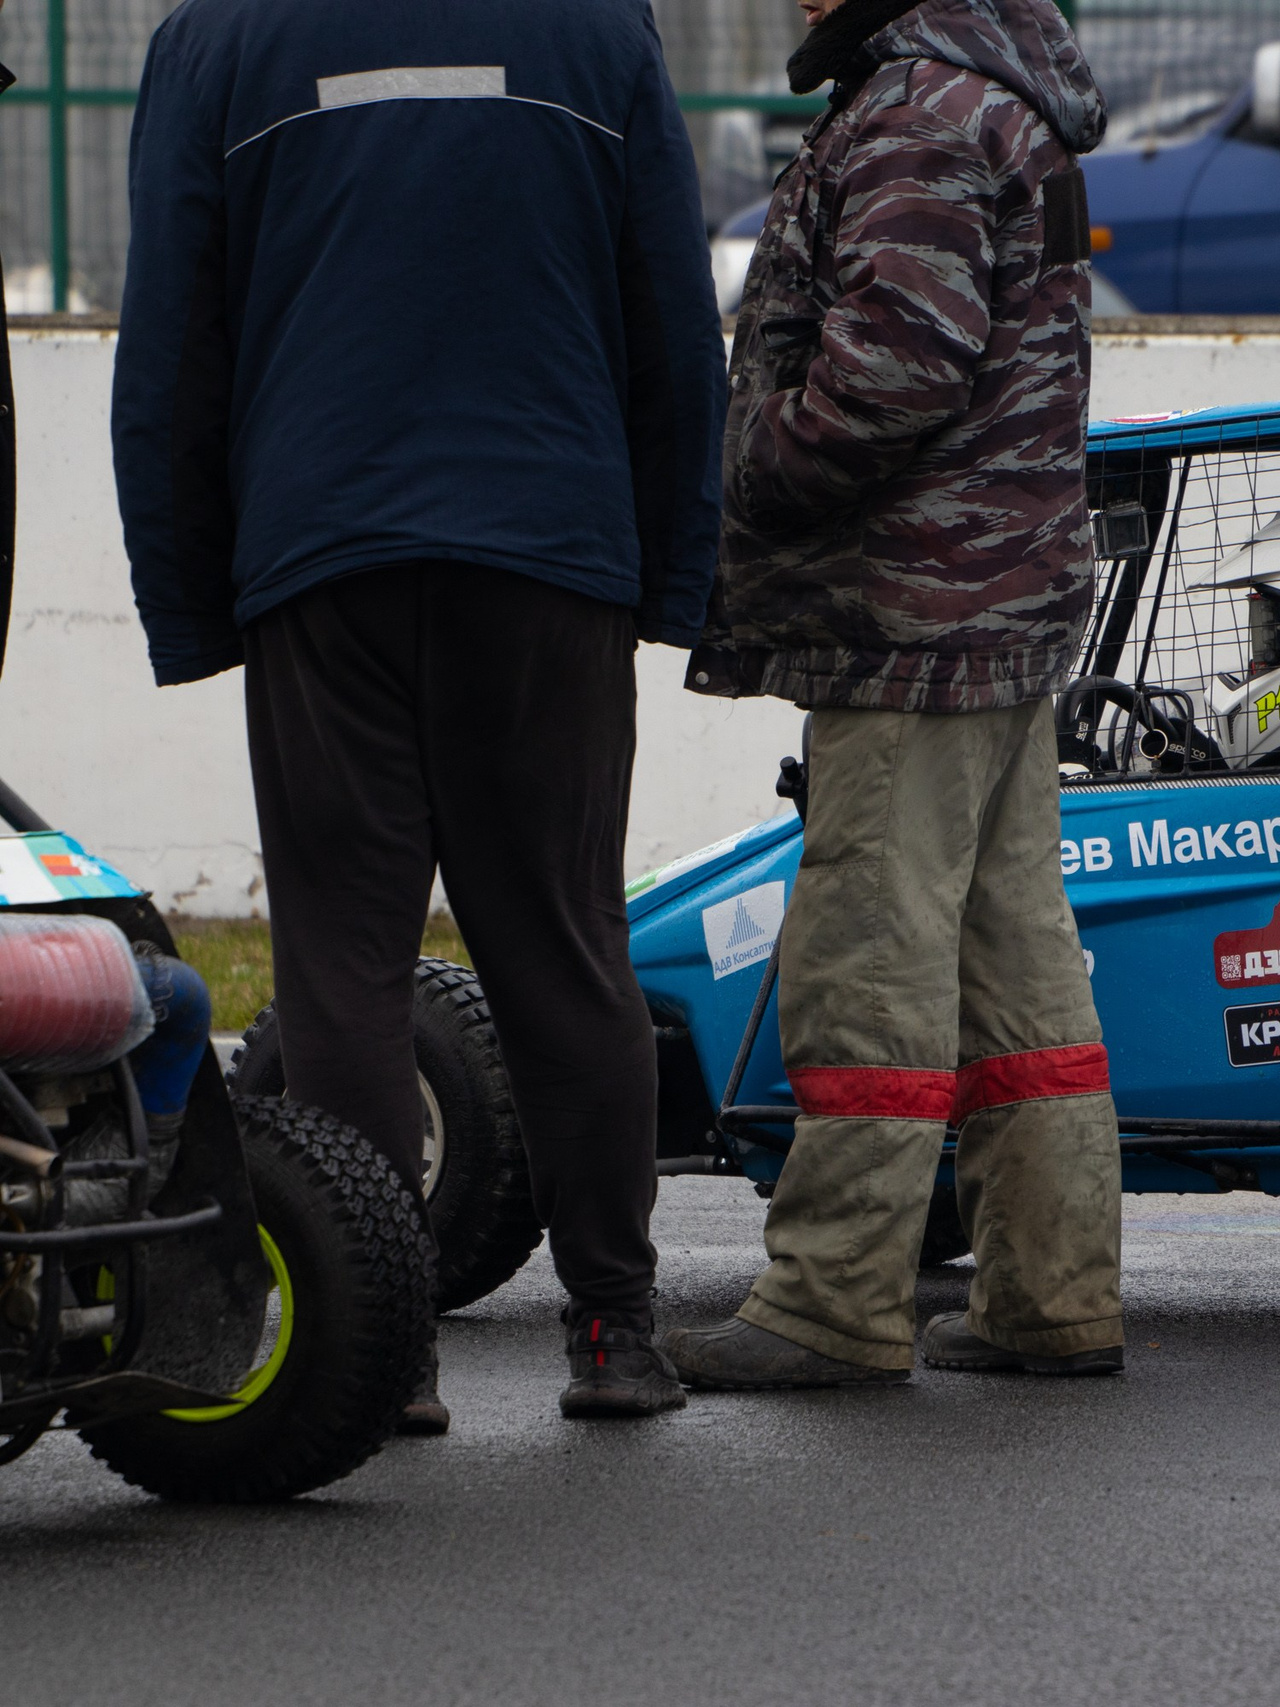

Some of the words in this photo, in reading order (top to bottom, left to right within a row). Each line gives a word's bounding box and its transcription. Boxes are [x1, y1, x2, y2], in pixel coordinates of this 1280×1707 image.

[1169, 743, 1206, 760] spco
[714, 956, 732, 974] АДВ
[732, 939, 776, 965] Консалти
